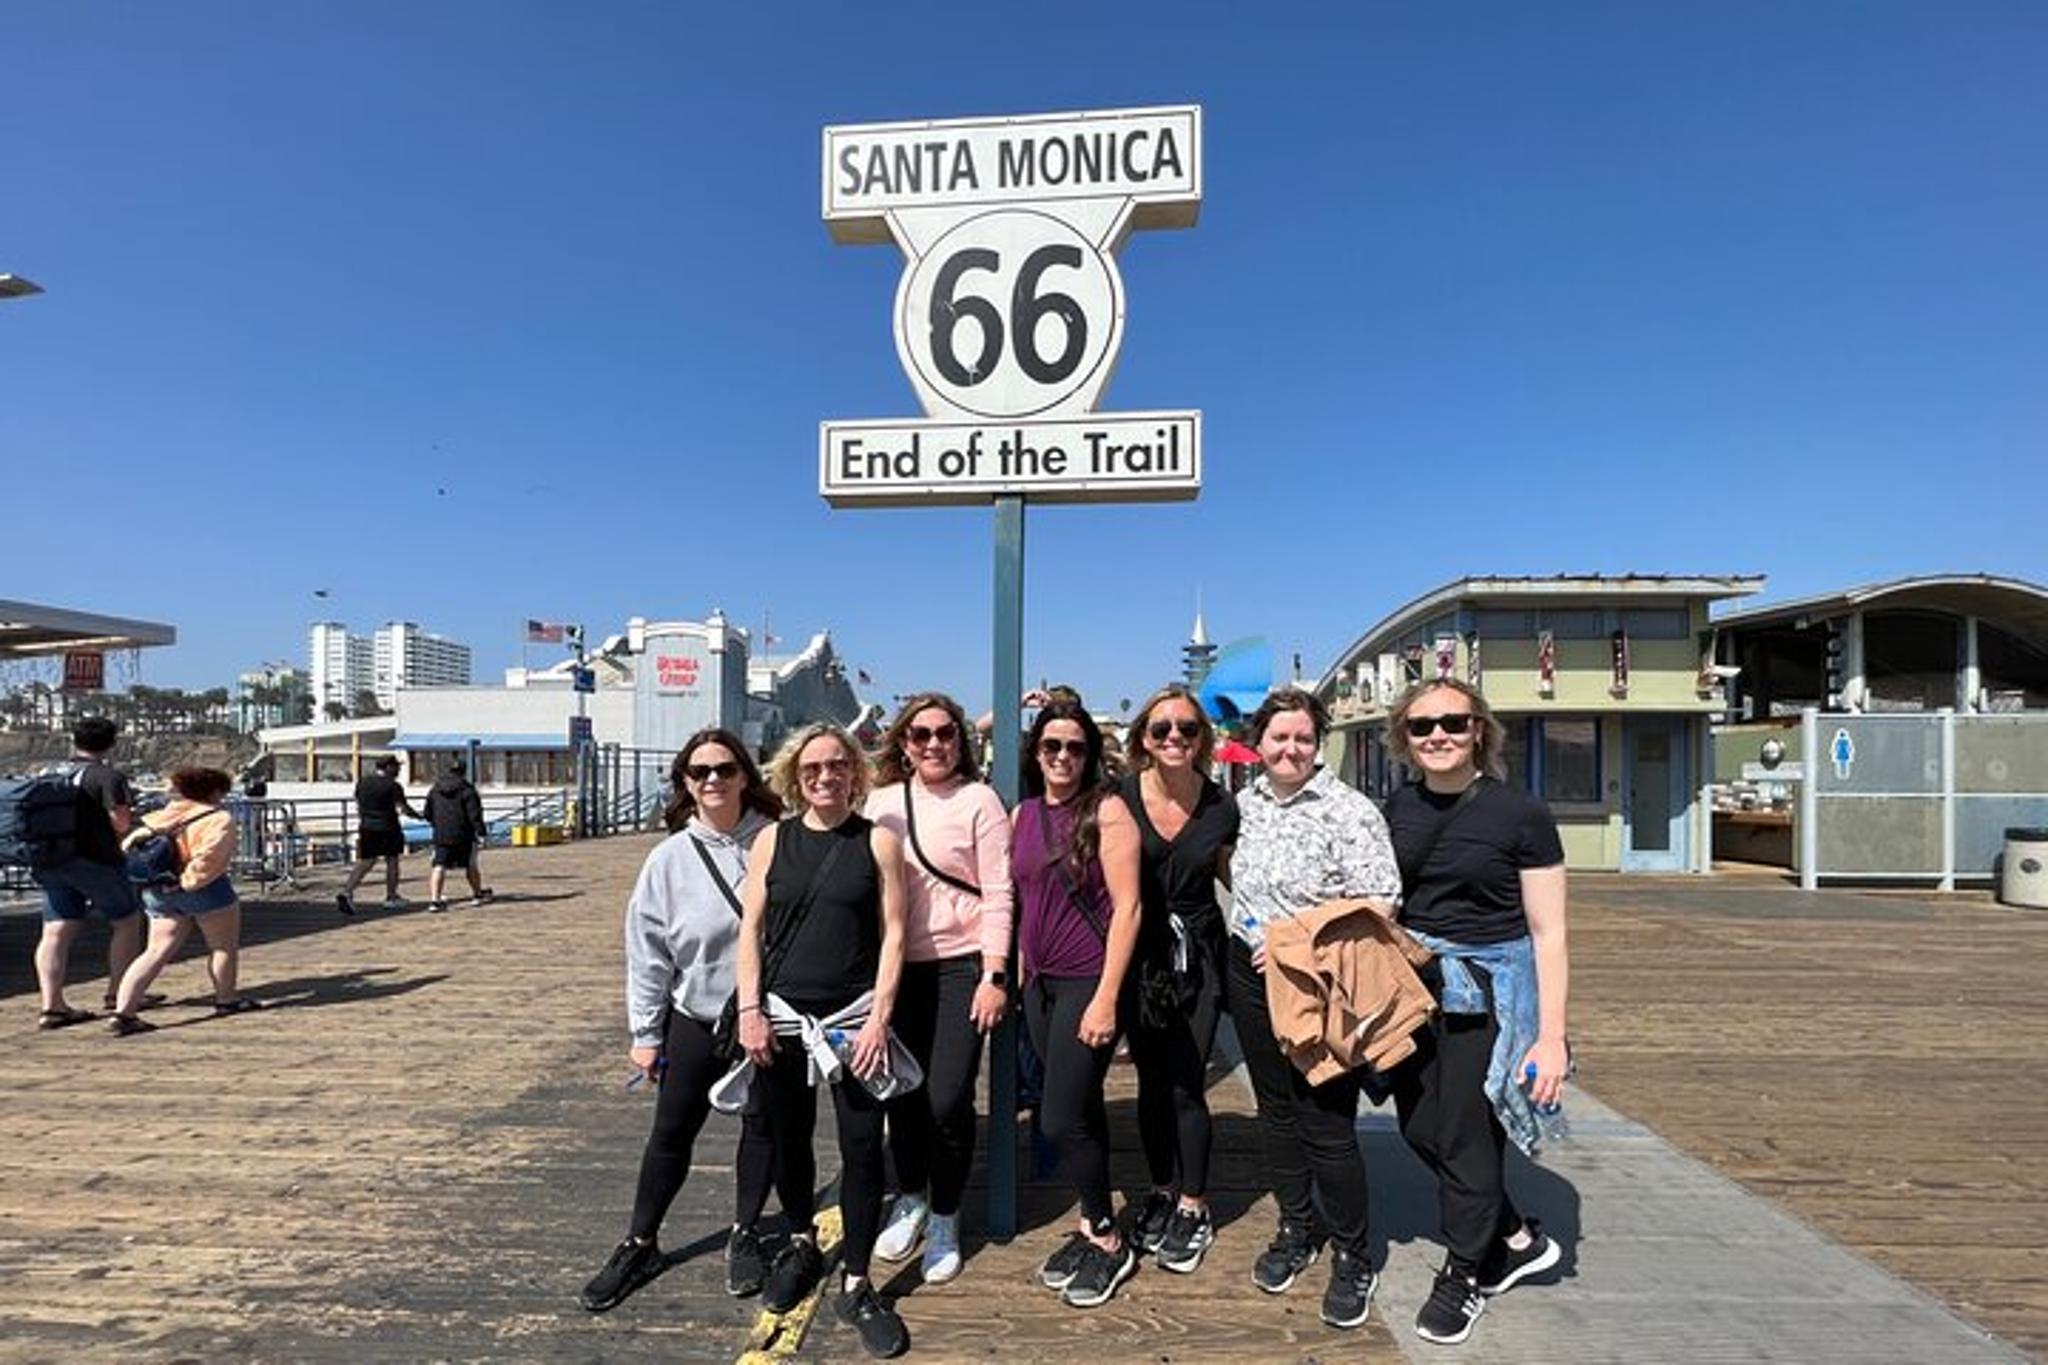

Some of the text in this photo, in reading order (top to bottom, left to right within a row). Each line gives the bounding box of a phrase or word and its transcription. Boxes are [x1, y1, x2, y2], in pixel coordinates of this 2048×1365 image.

[839, 127, 1183, 196] SANTA MONICA
[929, 244, 1088, 388] 66
[841, 425, 1179, 479] End of the Trail
[68, 655, 100, 678] ATM
